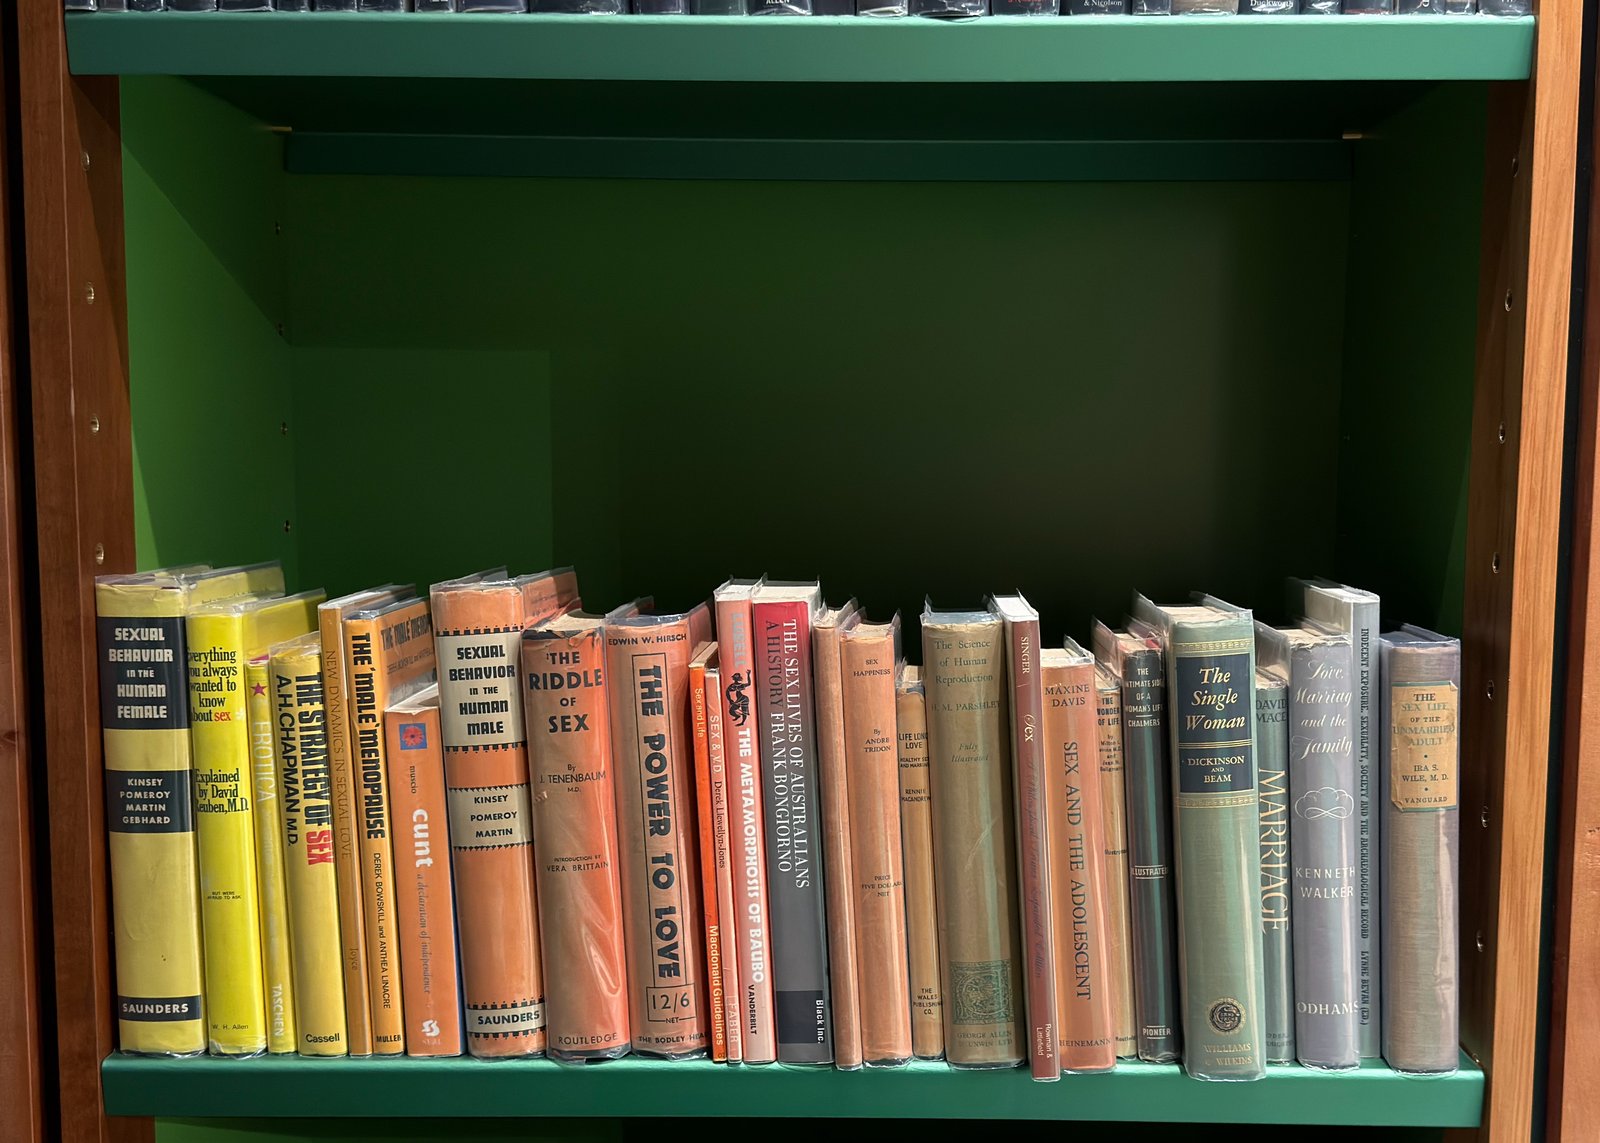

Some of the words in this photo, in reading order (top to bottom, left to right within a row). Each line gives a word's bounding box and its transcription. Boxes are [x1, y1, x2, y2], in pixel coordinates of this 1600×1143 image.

[766, 620, 780, 631] A
[114, 627, 165, 642] SEXUAL
[608, 638, 639, 646] EDWIN
[642, 636, 655, 644] W.
[656, 632, 687, 643] HIRSCH
[783, 618, 798, 654] THE
[352, 633, 372, 665] THE
[457, 644, 506, 660] SEXUAL
[935, 640, 953, 650] The
[958, 639, 991, 649] Science
[1361, 628, 1369, 668] INDECENT
[108, 648, 174, 662] BEHAVIOR
[550, 651, 581, 665] THE
[865, 658, 879, 666] SEX
[939, 657, 949, 667] of
[954, 657, 987, 666] Human
[1020, 636, 1030, 674] SINGER
[138, 669, 154, 678] THE
[202, 662, 238, 679] always
[325, 650, 338, 681] NEW
[449, 664, 516, 682] BEHAVIOR
[766, 636, 784, 707] HISTORY
[853, 668, 891, 677] HAPPINESS
[1137, 668, 1149, 676] THE
[529, 668, 604, 691] RIDDLE
[784, 658, 799, 690] SEX
[935, 673, 993, 687] Reproduction
[1199, 667, 1231, 684] The
[117, 684, 166, 698] HUMAN
[226, 679, 237, 692] to
[295, 672, 324, 710] THE
[483, 686, 498, 695] THE
[639, 665, 664, 717] THE
[1045, 684, 1090, 696] MAXINE
[198, 693, 226, 708] know
[560, 697, 577, 708] OF
[1052, 698, 1086, 708] DAVIS
[1102, 697, 1114, 705] THE
[1136, 692, 1145, 701] OF
[1191, 690, 1238, 711] Single
[1413, 693, 1436, 702] THE
[117, 705, 167, 719] FEMALE
[459, 699, 509, 716] HUMAN
[1401, 703, 1421, 712] SEX
[1427, 703, 1449, 711] LIFE
[214, 711, 231, 721] sex
[329, 686, 344, 753] DYNAMICS
[549, 713, 590, 734] SEX
[787, 693, 803, 743] LIVES
[1108, 718, 1119, 726] LIFE
[1127, 719, 1160, 727] CHALMERS
[1185, 715, 1246, 730] Woman
[1256, 712, 1286, 723] MACE
[1300, 715, 1325, 727] and
[1330, 714, 1347, 727] the
[467, 720, 504, 736] MALE
[710, 715, 720, 744] SEX
[1393, 723, 1455, 734] UNMARRIED
[738, 728, 750, 757] THE
[771, 712, 787, 769] FRANK
[898, 733, 912, 741] LIFE
[1359, 718, 1369, 762] SEXUALITY,
[1408, 737, 1443, 746] ADULT
[298, 710, 331, 801] STRATEGY
[864, 745, 892, 753] TRIDON
[1292, 735, 1352, 760] Family
[253, 721, 276, 802] EROTICA
[788, 746, 804, 768] OF
[1063, 741, 1080, 775] SEX
[1188, 756, 1245, 766] DICKINSON
[334, 759, 345, 772] IN
[127, 778, 164, 787] KINSEY
[410, 765, 418, 794] muscio
[548, 770, 607, 784] TENENBAUM
[1204, 774, 1232, 783] BEAM
[1360, 765, 1369, 799] SOCIETY
[1401, 775, 1427, 783] WILE,
[198, 784, 208, 800] by
[211, 783, 239, 798] David
[643, 733, 671, 838] POWER
[714, 781, 723, 805] Derek
[120, 791, 171, 800] POMEROY
[336, 777, 348, 825] SEXUAL
[474, 794, 508, 804] KINSEY
[1404, 796, 1448, 804] VANGUARD
[125, 803, 166, 812] MARTIN
[1065, 786, 1082, 826] AND
[122, 816, 171, 825] GEBHARD
[304, 804, 333, 826] OF
[470, 811, 517, 822] POMEROY
[739, 763, 760, 898] METAMORPHOSIS
[773, 775, 793, 873] BONGIORNO
[790, 772, 810, 889] AUSTRALIANS
[1360, 820, 1369, 836] THE
[286, 818, 299, 847] M.D.
[412, 808, 434, 868] cunt
[475, 827, 513, 838] MARTIN
[715, 806, 726, 869] Llewellyn-Jones
[306, 829, 334, 865] SEX
[340, 828, 350, 860] LOVE
[1258, 768, 1289, 935] MARRIAGE
[1068, 834, 1084, 871] THE
[374, 853, 383, 879] DEREK
[547, 864, 567, 873] VERA
[572, 861, 609, 872] BRITTAIN
[651, 852, 675, 890] TO
[1296, 866, 1355, 880] KENNETH
[1360, 838, 1369, 907] ARCHAEOLOGICAL
[1300, 886, 1354, 899] WALKER
[376, 881, 386, 923] BOWSKILL
[748, 904, 760, 924] OF
[378, 926, 386, 938] and
[1361, 909, 1370, 939] RECORD
[654, 905, 681, 979] LOVE
[1070, 880, 1091, 1000] ADOLESCENT
[379, 940, 388, 973] ANTHEA
[709, 925, 721, 988] Macdonald
[749, 929, 764, 983] BAUBO
[1360, 951, 1369, 977] LYNNE
[382, 975, 391, 1008] LINACRE
[1360, 979, 1369, 1004] BEVAN
[122, 1003, 189, 1014] SAUNDERS
[651, 991, 690, 1013] 12/6
[748, 985, 757, 1035] VANDERBILT
[1296, 1001, 1358, 1015] ODHAMS
[272, 984, 285, 1037] TASCHEN
[478, 1010, 540, 1025] SAUNDERS
[711, 988, 723, 1046] Guidelines
[815, 999, 825, 1025] Black
[665, 1016, 681, 1024] NET
[728, 1003, 738, 1043] FABER
[305, 1033, 340, 1043] Cassell
[376, 1034, 402, 1043] MULLER
[558, 1032, 618, 1045] ROUTLEDGE
[655, 1036, 685, 1044] BODLEY
[816, 1026, 826, 1044] Inc.
[957, 1031, 986, 1039] GEORGE
[1142, 1028, 1171, 1036] PIONEER
[1060, 1038, 1111, 1048] HEINEMANN
[1203, 1043, 1251, 1053] WILLIAMS
[1215, 1056, 1252, 1066] WILKINS
